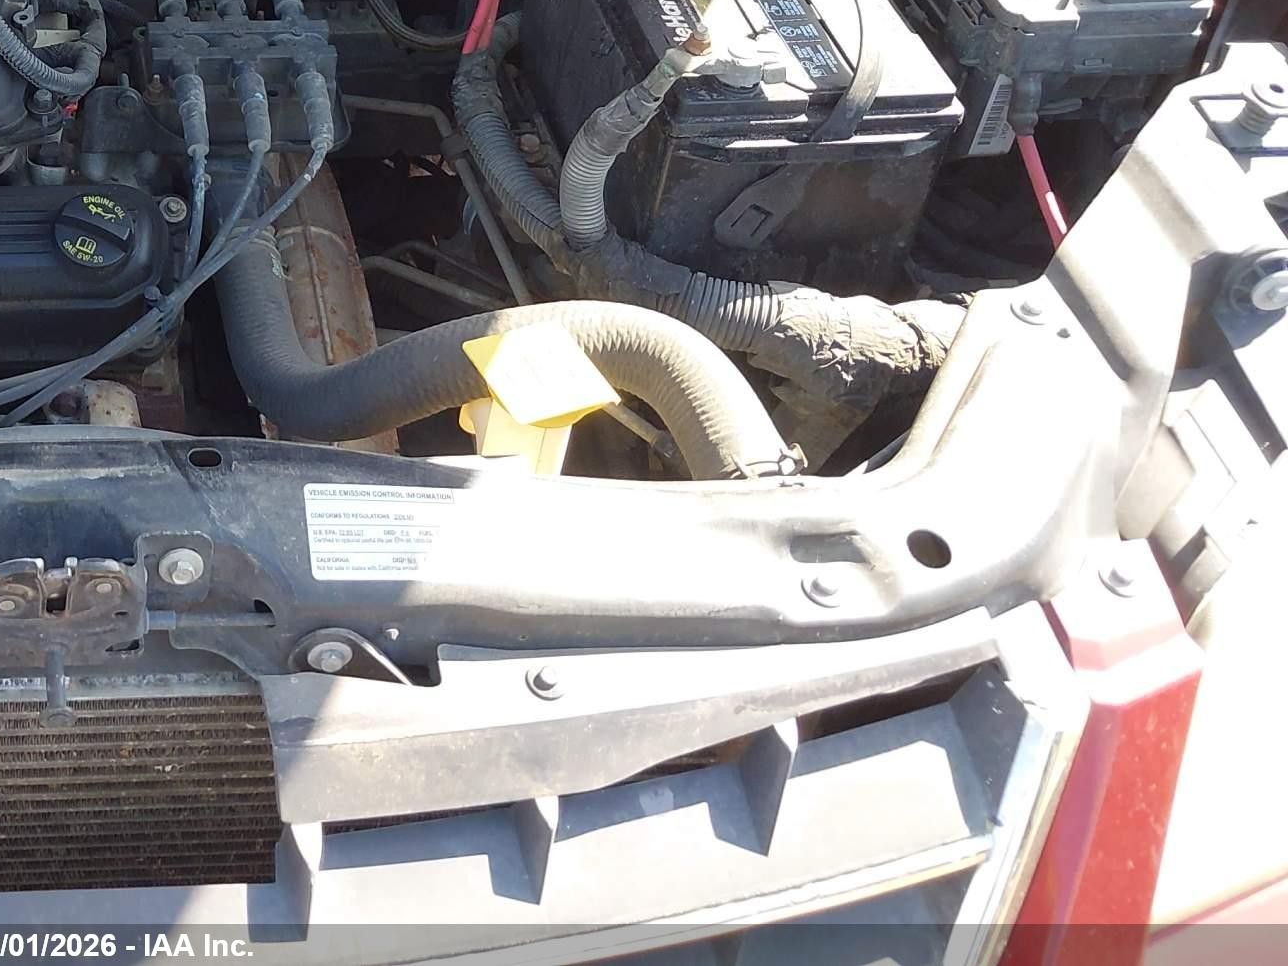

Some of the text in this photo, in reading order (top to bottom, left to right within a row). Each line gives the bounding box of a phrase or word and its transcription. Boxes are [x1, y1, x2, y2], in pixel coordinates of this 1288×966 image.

[83, 196, 126, 219] ENGINE OIL
[63, 240, 104, 263] SAE 5W-20
